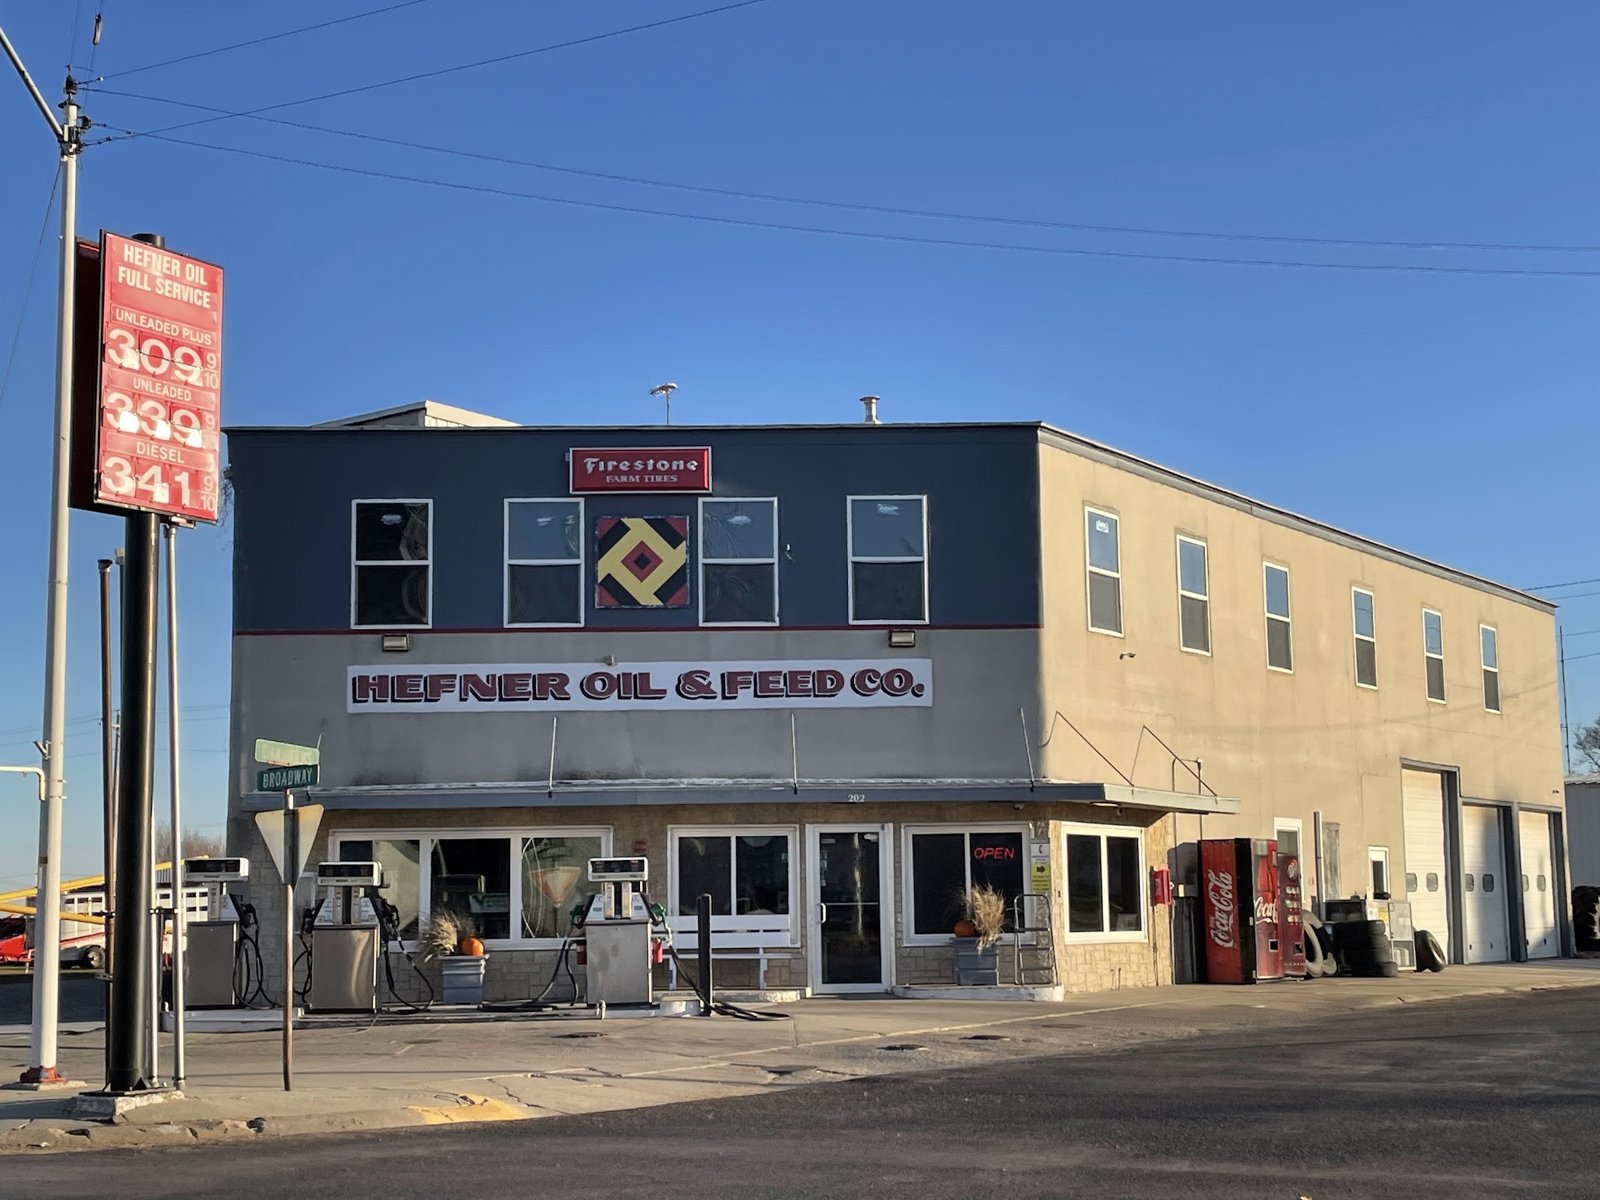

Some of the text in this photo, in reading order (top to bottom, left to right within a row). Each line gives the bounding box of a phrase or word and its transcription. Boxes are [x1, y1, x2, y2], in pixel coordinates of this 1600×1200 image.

[123, 244, 208, 286] HEFNER OIL
[118, 265, 211, 309] FULL SERVICE
[115, 308, 212, 346] UNLEADED PLUS
[108, 328, 203, 386] 309
[133, 377, 191, 401] UNLEADED
[106, 392, 202, 448] 339
[136, 442, 185, 464] DIESEL
[583, 457, 699, 475] Firestone
[104, 456, 191, 508] 341
[606, 474, 678, 483] FARM TIRES
[352, 668, 925, 704] HEFNER OIL & FEED CO.
[262, 768, 313, 788] BROADWAY
[847, 793, 865, 803] 202
[974, 847, 1015, 860] OPEN
